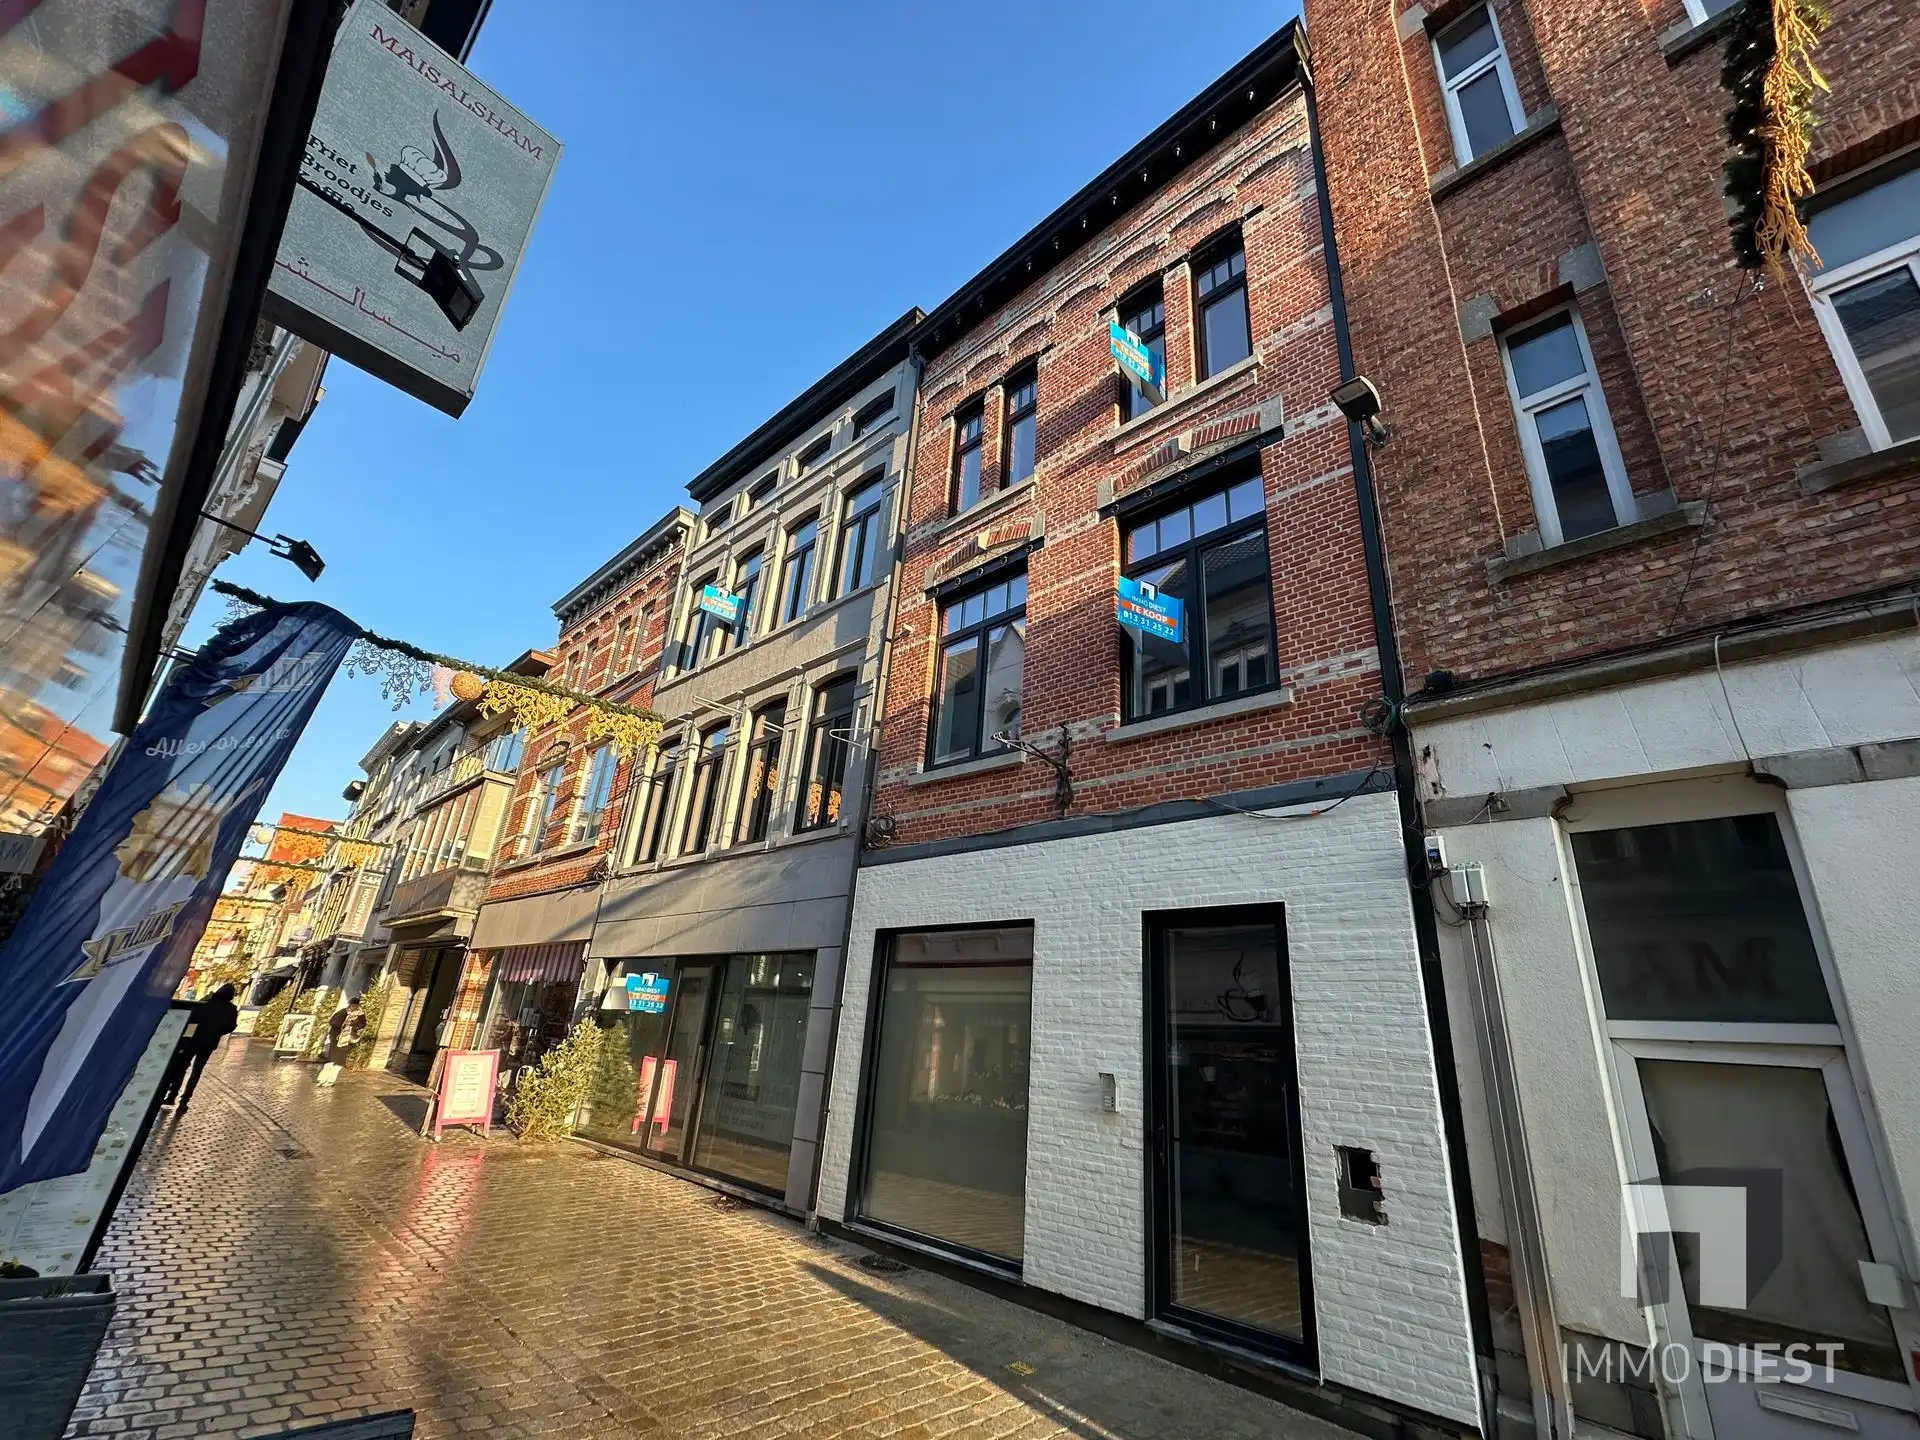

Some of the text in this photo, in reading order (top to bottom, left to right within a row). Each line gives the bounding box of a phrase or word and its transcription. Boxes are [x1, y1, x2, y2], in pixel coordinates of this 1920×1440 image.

[369, 24, 543, 160] MAISALSHAM
[307, 134, 357, 175] Friet
[301, 150, 394, 218] Broodjes
[1130, 603, 1168, 622] TE KOOP
[1132, 595, 1166, 613] IMMO DIEST
[1123, 610, 1138, 621] 013
[1140, 617, 1150, 626] 31
[1152, 621, 1163, 630] 25
[1164, 626, 1174, 635] 22
